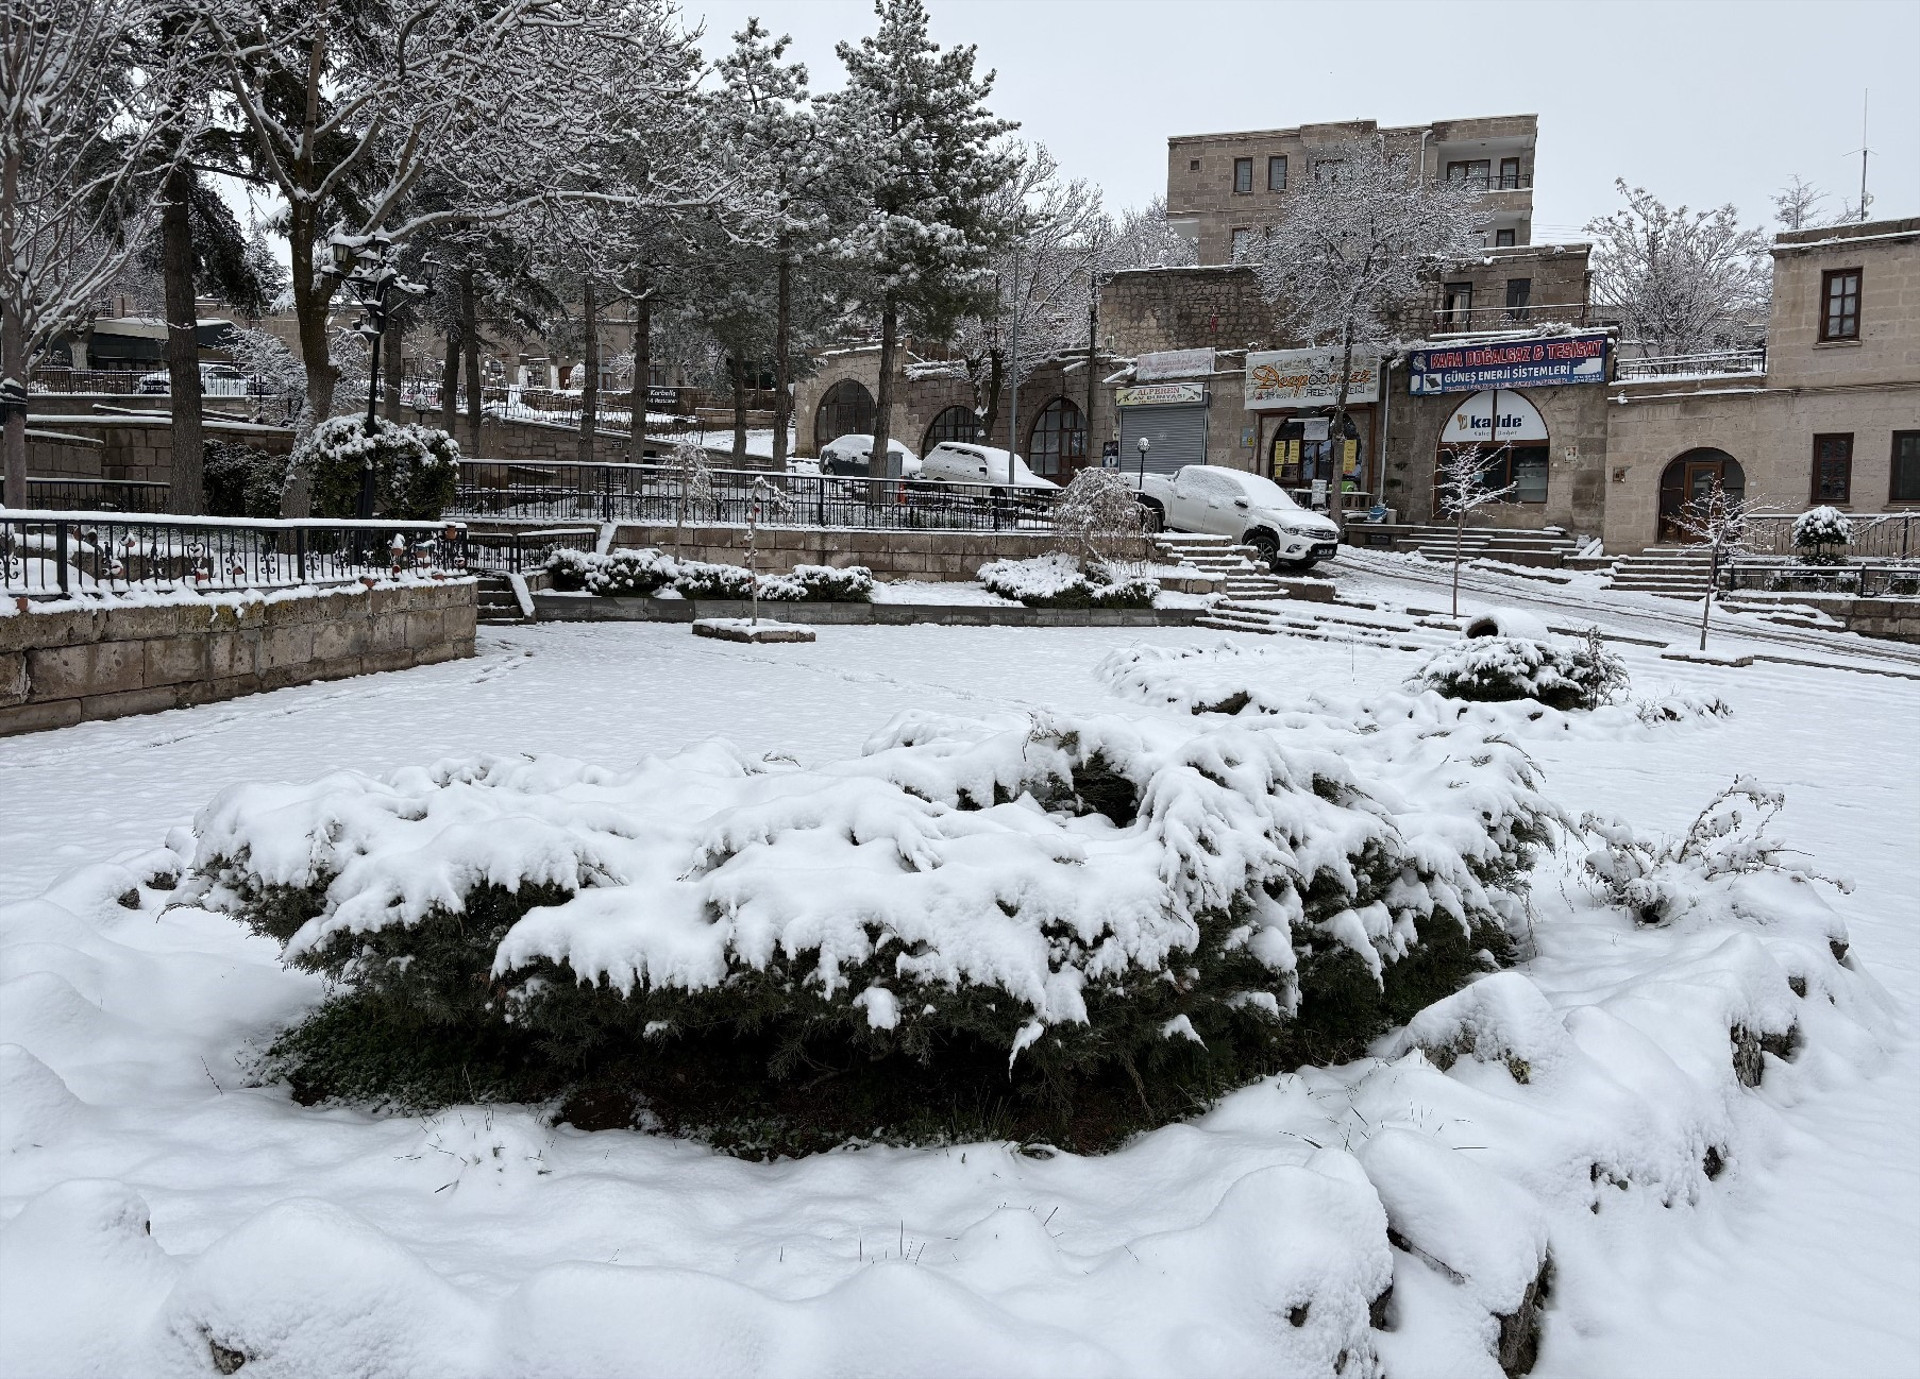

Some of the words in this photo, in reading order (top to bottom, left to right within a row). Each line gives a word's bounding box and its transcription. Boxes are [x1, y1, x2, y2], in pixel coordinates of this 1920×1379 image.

[1431, 350, 1462, 369] KARA
[1465, 345, 1531, 367] DOĞALGAZ
[1533, 345, 1545, 360] &
[1548, 339, 1604, 359] TESİSAT
[1444, 369, 1476, 385] GÜNEŞ
[1478, 367, 1511, 381] ENERJİ
[1512, 360, 1571, 379] SİSTEMLERİ
[1137, 387, 1180, 396] ALPEREN
[1470, 414, 1522, 428] kalde
